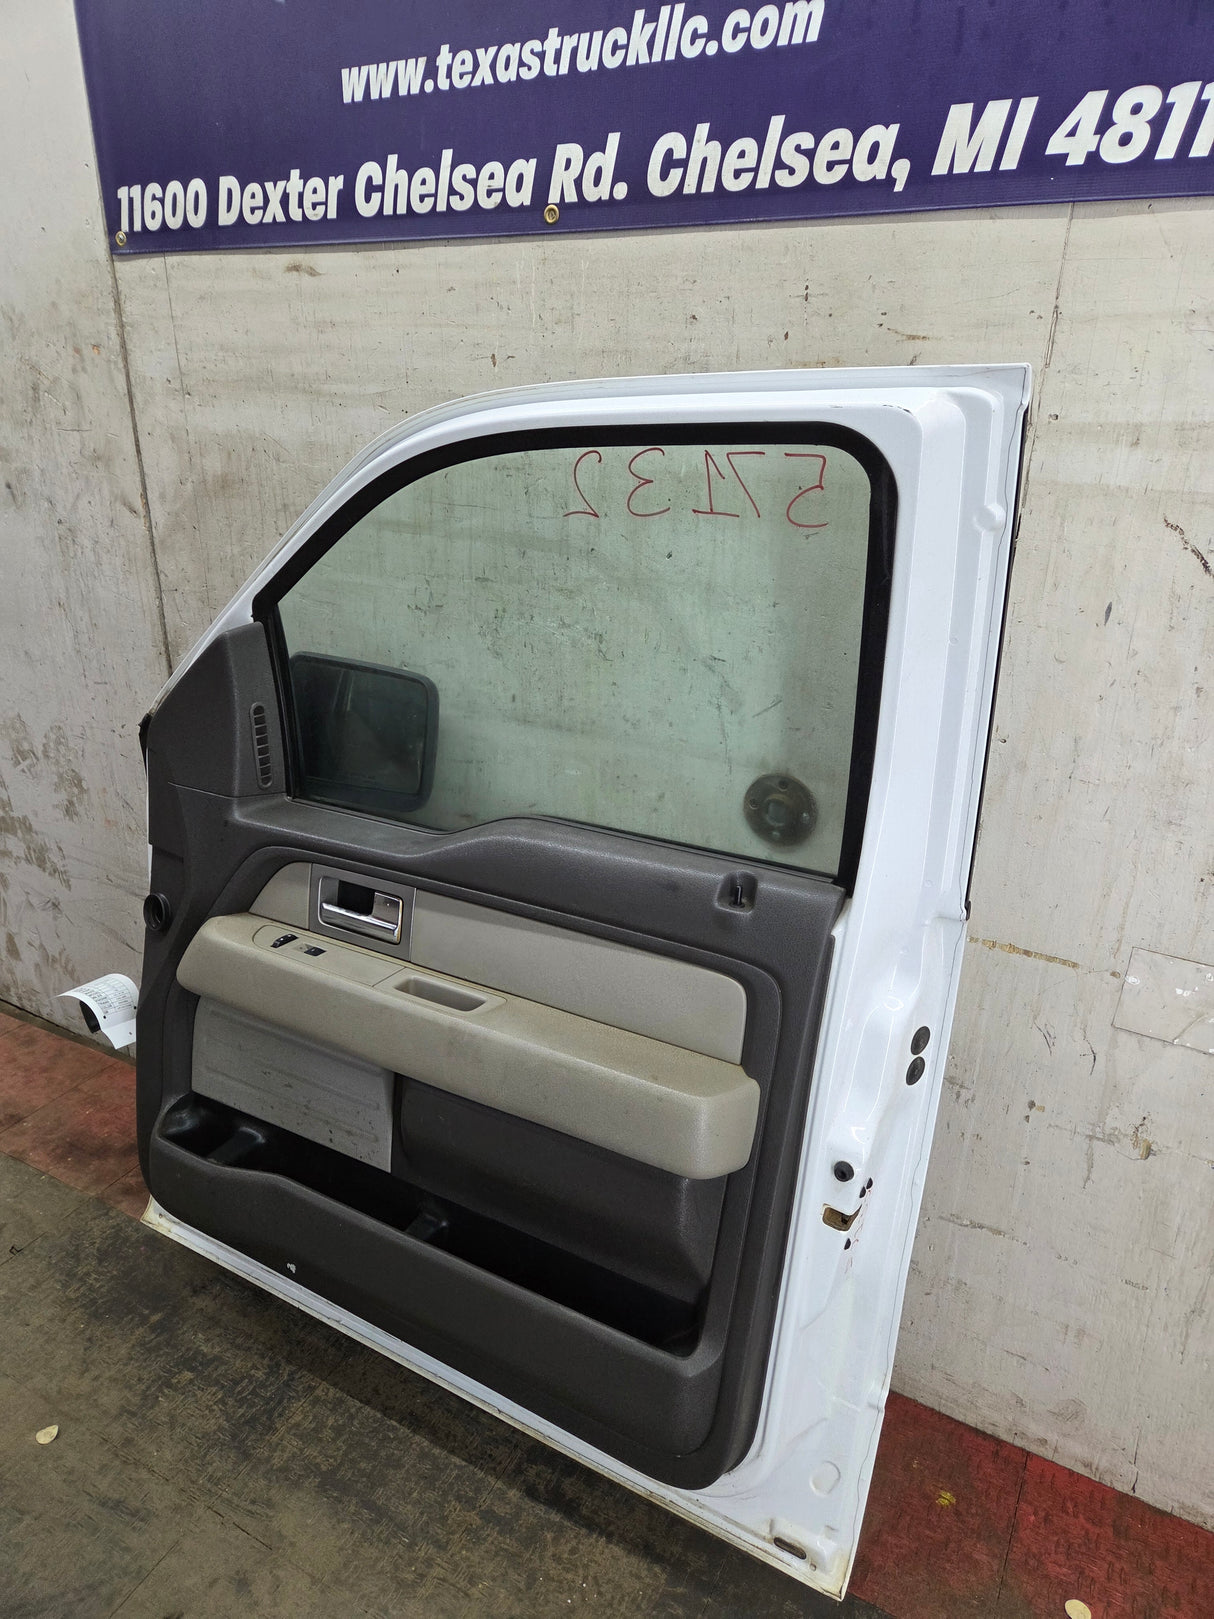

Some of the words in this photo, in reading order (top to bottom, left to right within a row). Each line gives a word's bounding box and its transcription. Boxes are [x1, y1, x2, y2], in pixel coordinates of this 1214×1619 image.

[341, 0, 826, 104] www.texastruckllc.com
[116, 177, 208, 232] 11600
[218, 168, 345, 226] Dexter
[354, 149, 538, 218] Chelsea
[547, 132, 628, 204] Rd.
[646, 114, 911, 198] Chelsea,
[930, 96, 1040, 176] MI
[1044, 80, 1214, 167] 4811
